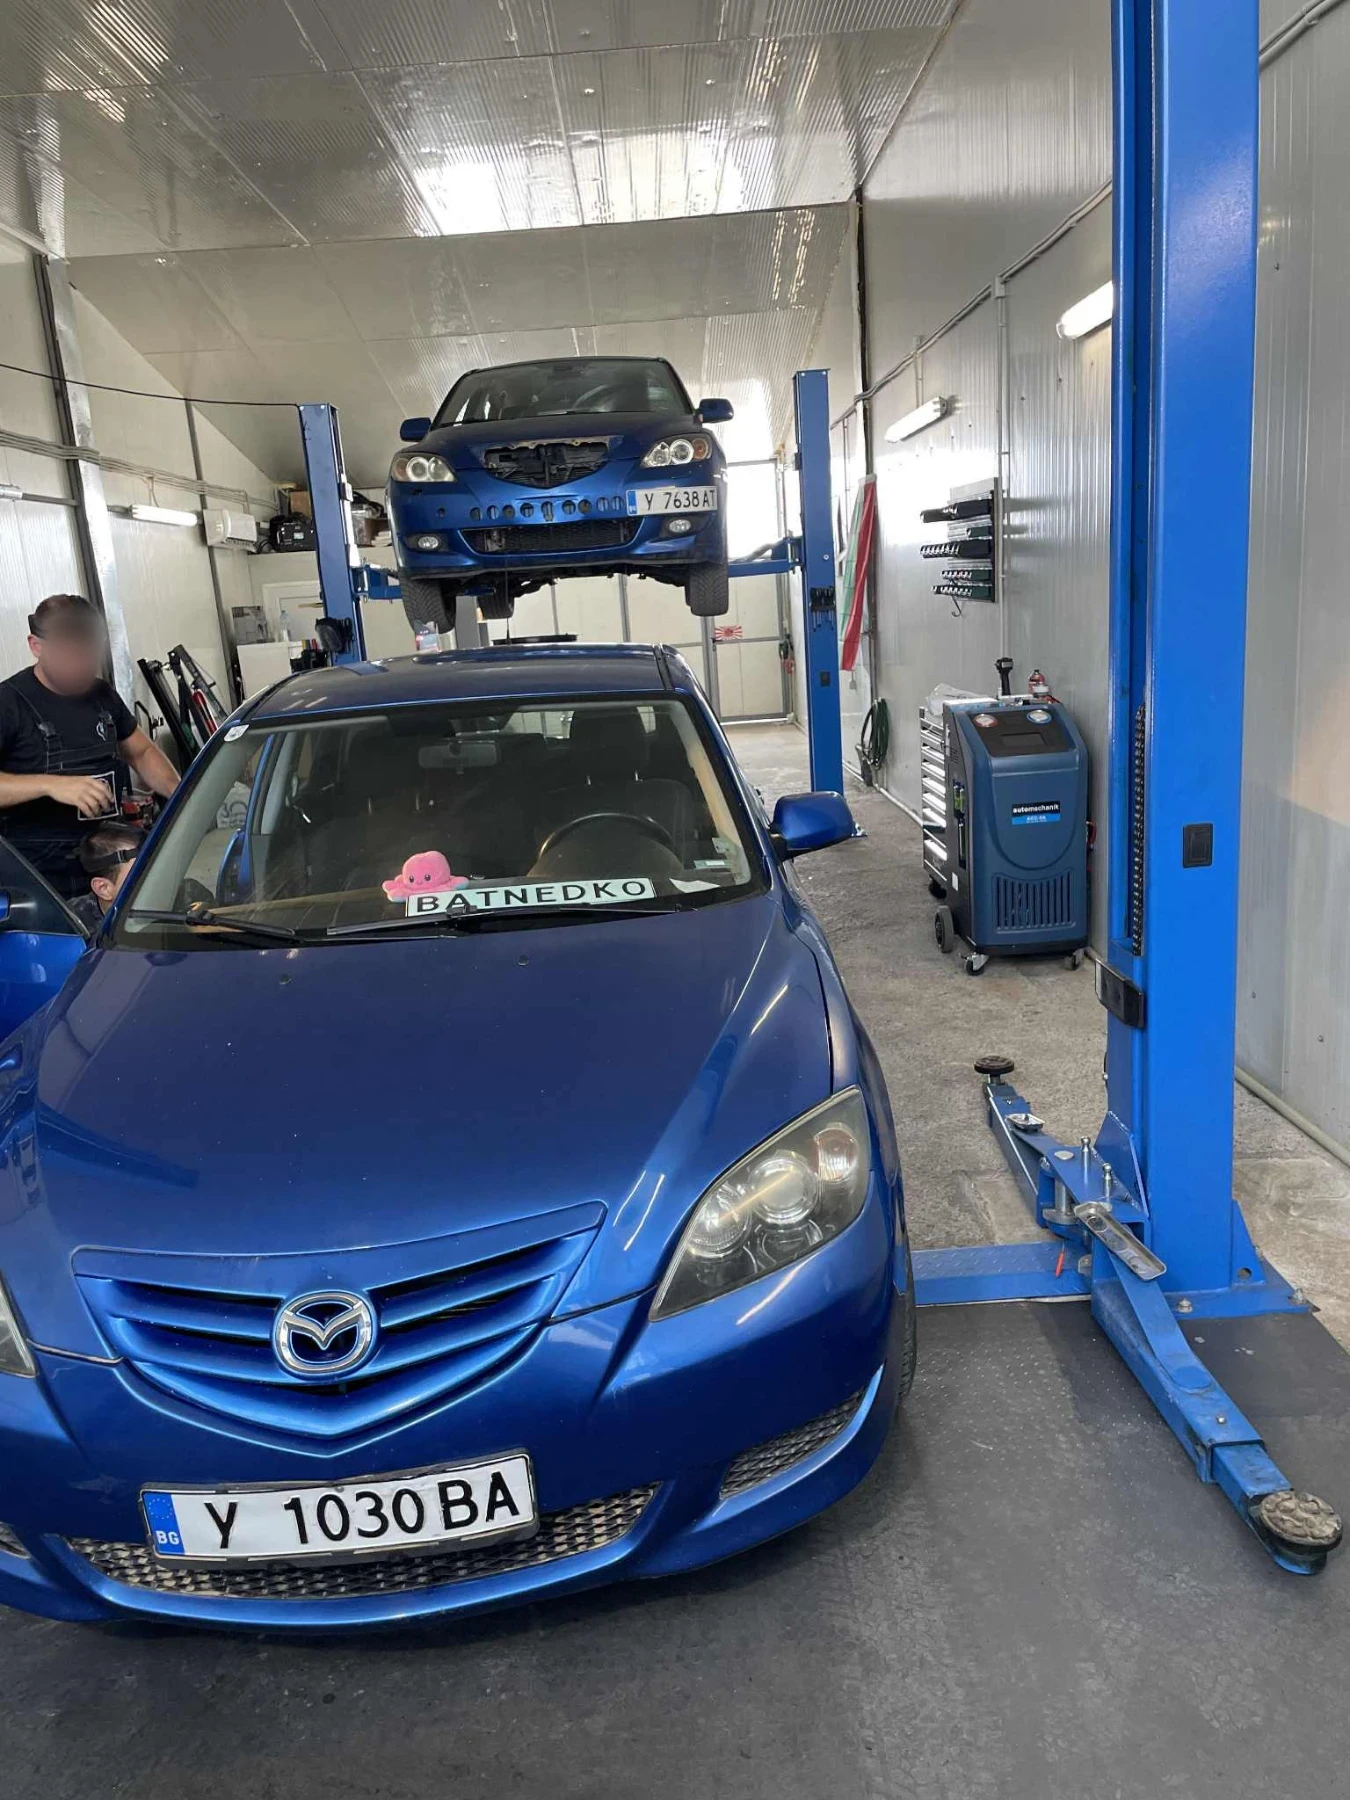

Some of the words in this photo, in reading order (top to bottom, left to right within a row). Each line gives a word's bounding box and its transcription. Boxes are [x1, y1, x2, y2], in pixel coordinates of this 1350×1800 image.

[644, 493, 654, 511] Y
[416, 881, 647, 913] BATNEDKO
[203, 1501, 238, 1549] Y
[282, 1488, 425, 1544] 1030
[155, 1530, 180, 1544] BG
